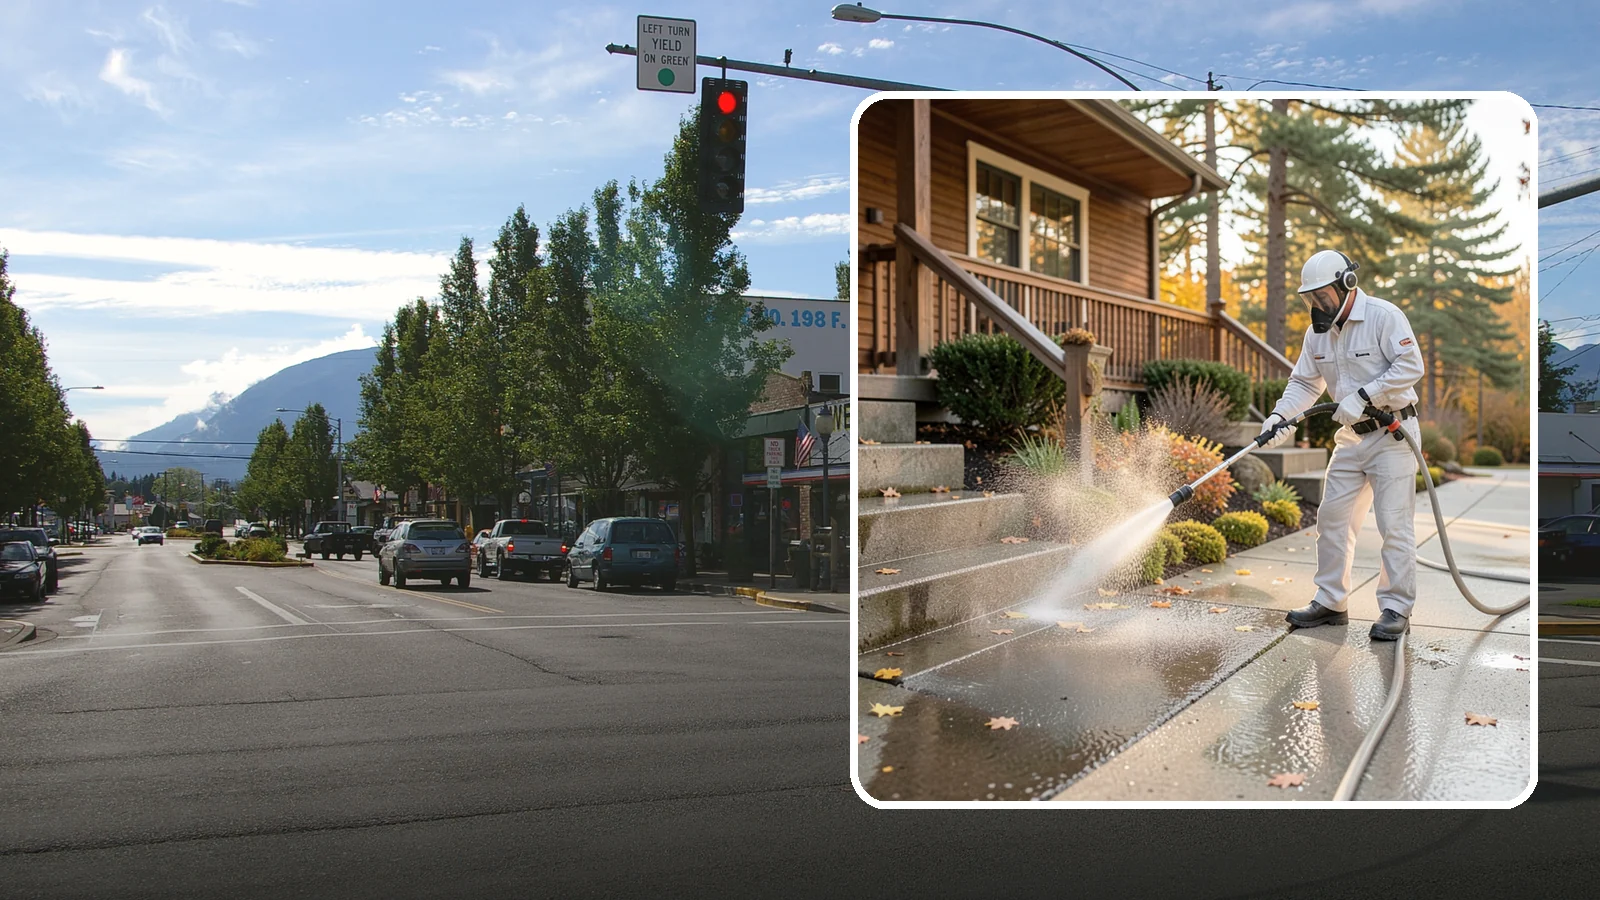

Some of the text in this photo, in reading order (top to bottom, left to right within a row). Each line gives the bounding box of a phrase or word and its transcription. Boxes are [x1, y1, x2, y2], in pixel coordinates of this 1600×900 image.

[643, 23, 690, 36] LEFT TURN
[652, 38, 682, 52] YIELD
[644, 53, 689, 66] ON GREEN
[791, 309, 826, 328] 198
[831, 311, 846, 329] F.
